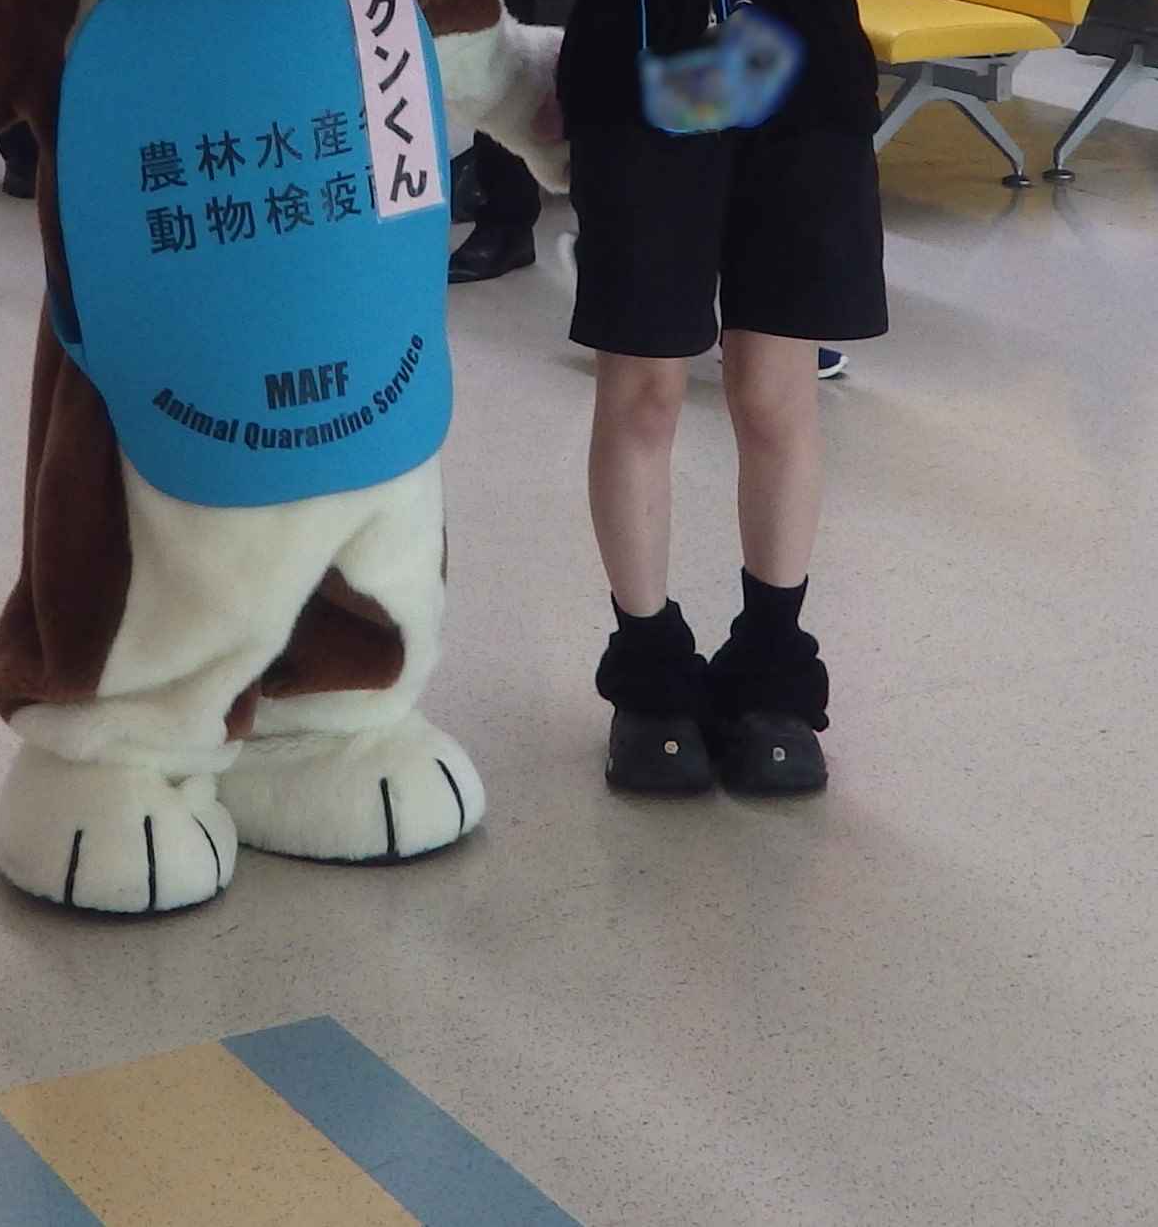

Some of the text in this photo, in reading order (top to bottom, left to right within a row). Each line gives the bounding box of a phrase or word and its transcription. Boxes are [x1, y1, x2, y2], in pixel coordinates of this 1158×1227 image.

[140, 106, 368, 192] 農林水産
[152, 334, 424, 450] Animal Quarantine Service
[264, 360, 349, 410] MAFF
